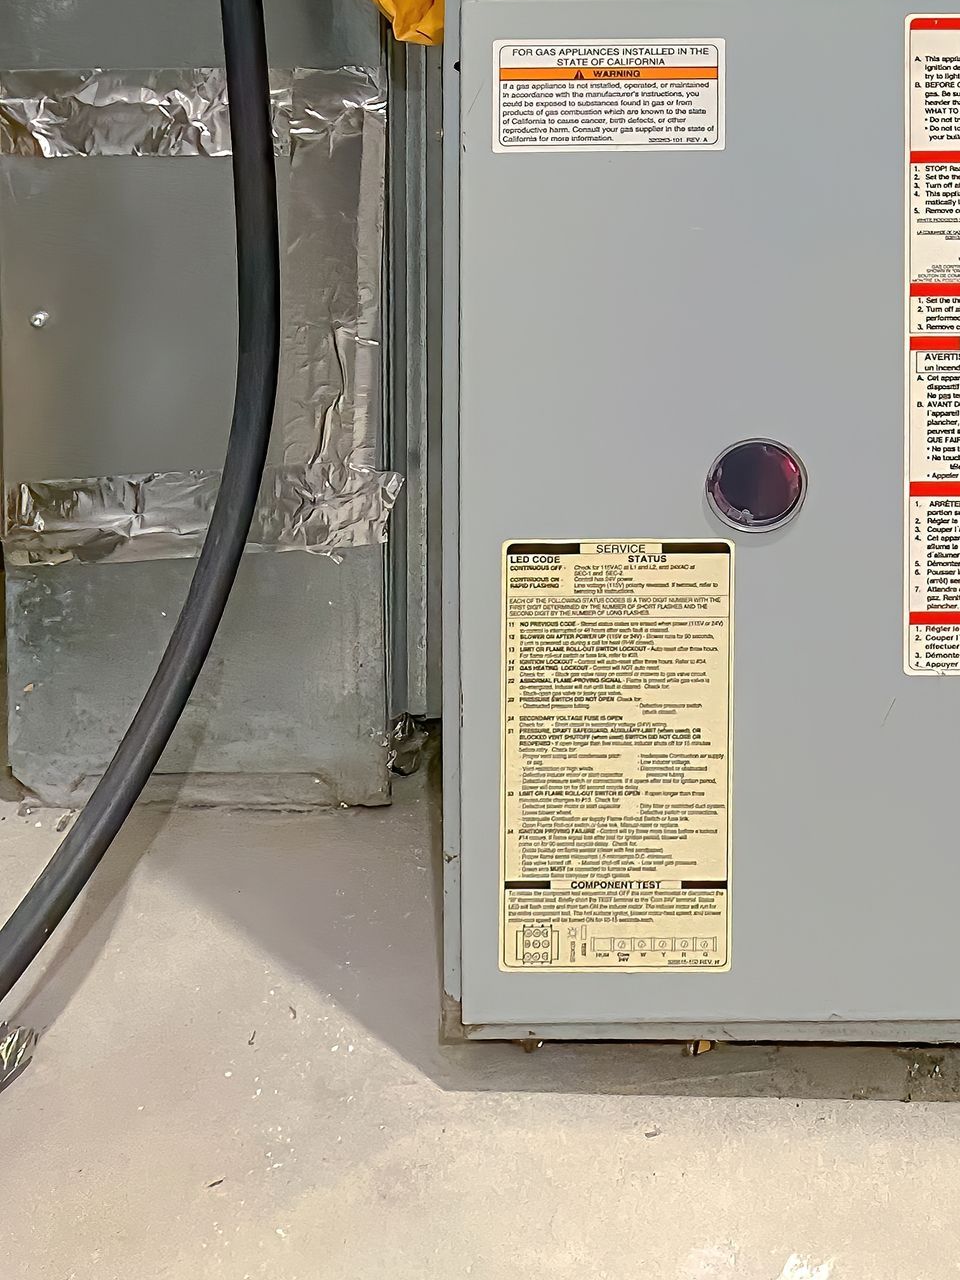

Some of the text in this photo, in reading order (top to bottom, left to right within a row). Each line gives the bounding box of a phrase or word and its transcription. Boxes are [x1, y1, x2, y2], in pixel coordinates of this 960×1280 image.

[558, 48, 620, 56] APPLIANCES
[556, 58, 589, 66] STATE
[590, 58, 605, 66] OF
[593, 70, 641, 78] WARNING
[596, 544, 646, 554] SERVICE
[627, 555, 667, 563] STATUS
[570, 881, 662, 889] COMPONENT TEST
